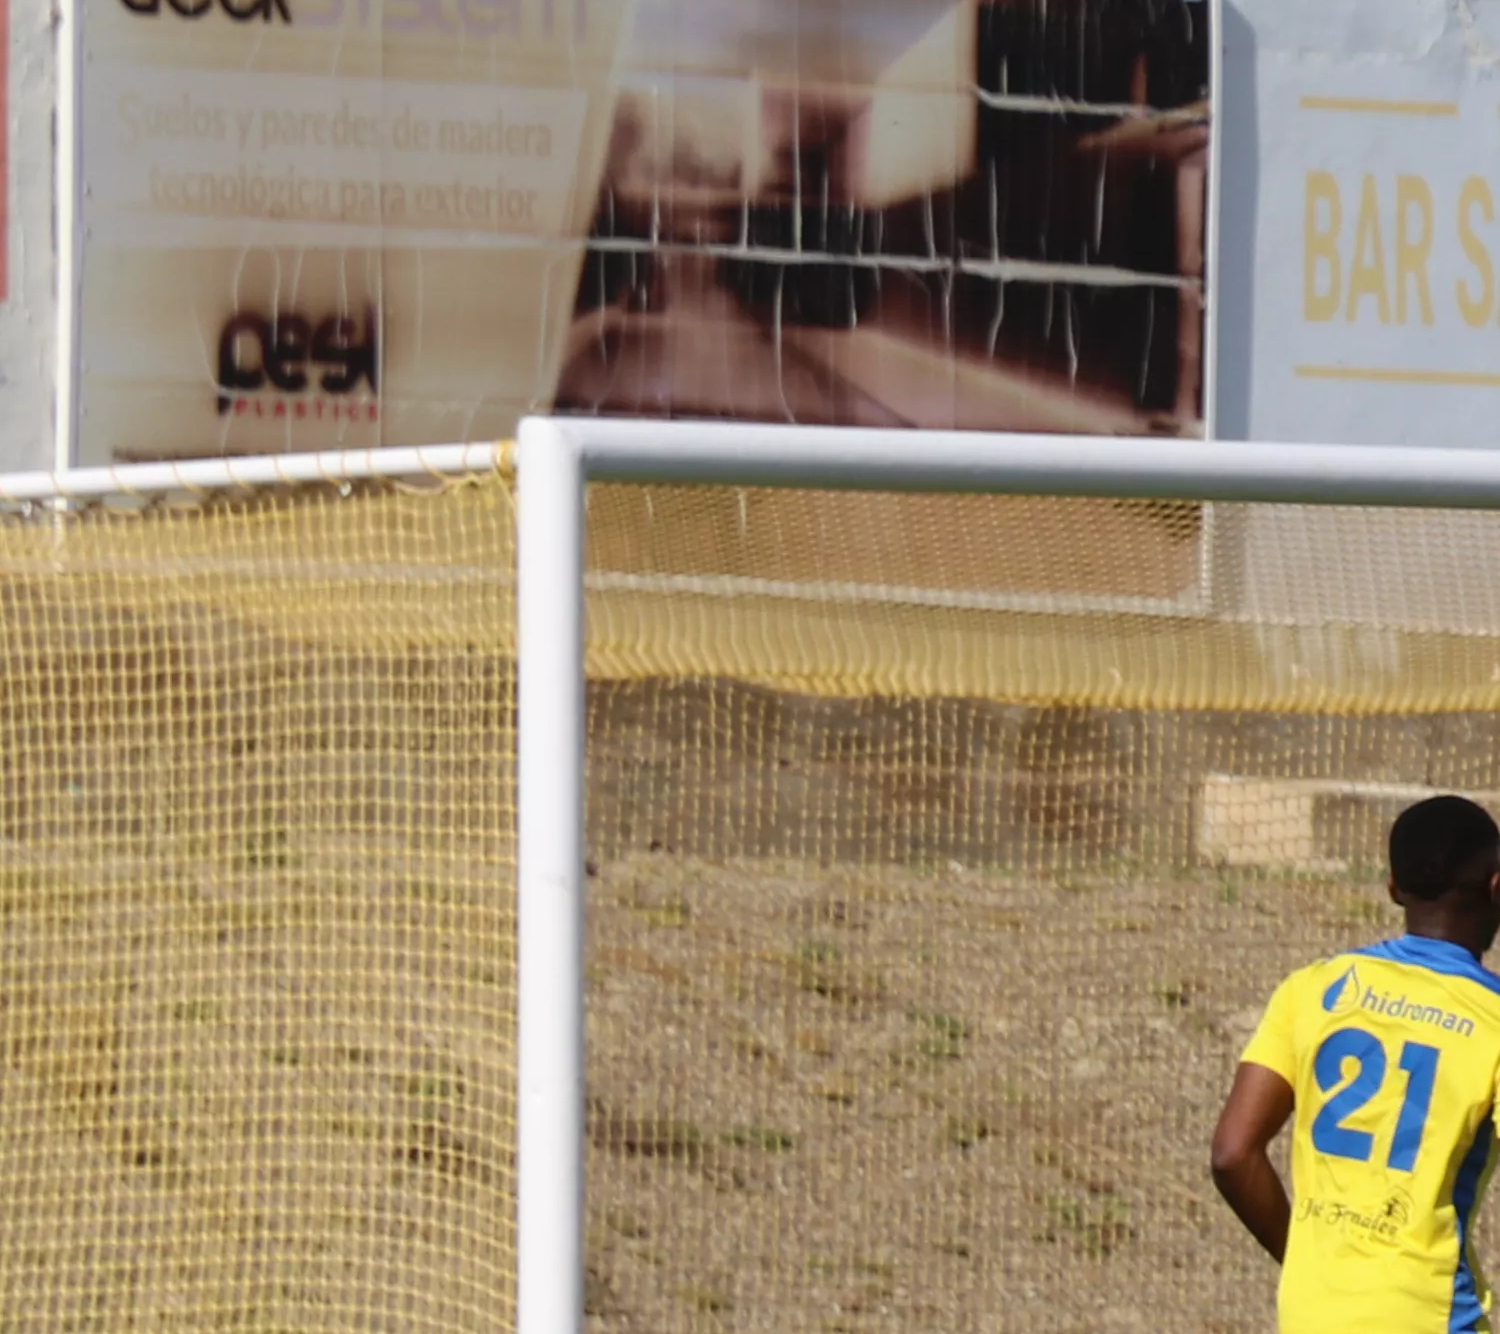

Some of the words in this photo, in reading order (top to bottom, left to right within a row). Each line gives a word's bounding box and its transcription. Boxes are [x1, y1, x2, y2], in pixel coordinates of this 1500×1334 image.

[392, 102, 432, 153] de
[438, 106, 553, 157] madera
[1303, 170, 1435, 328] BAR
[1360, 985, 1476, 1038] hidroman
[1310, 1026, 1442, 1173] 21
